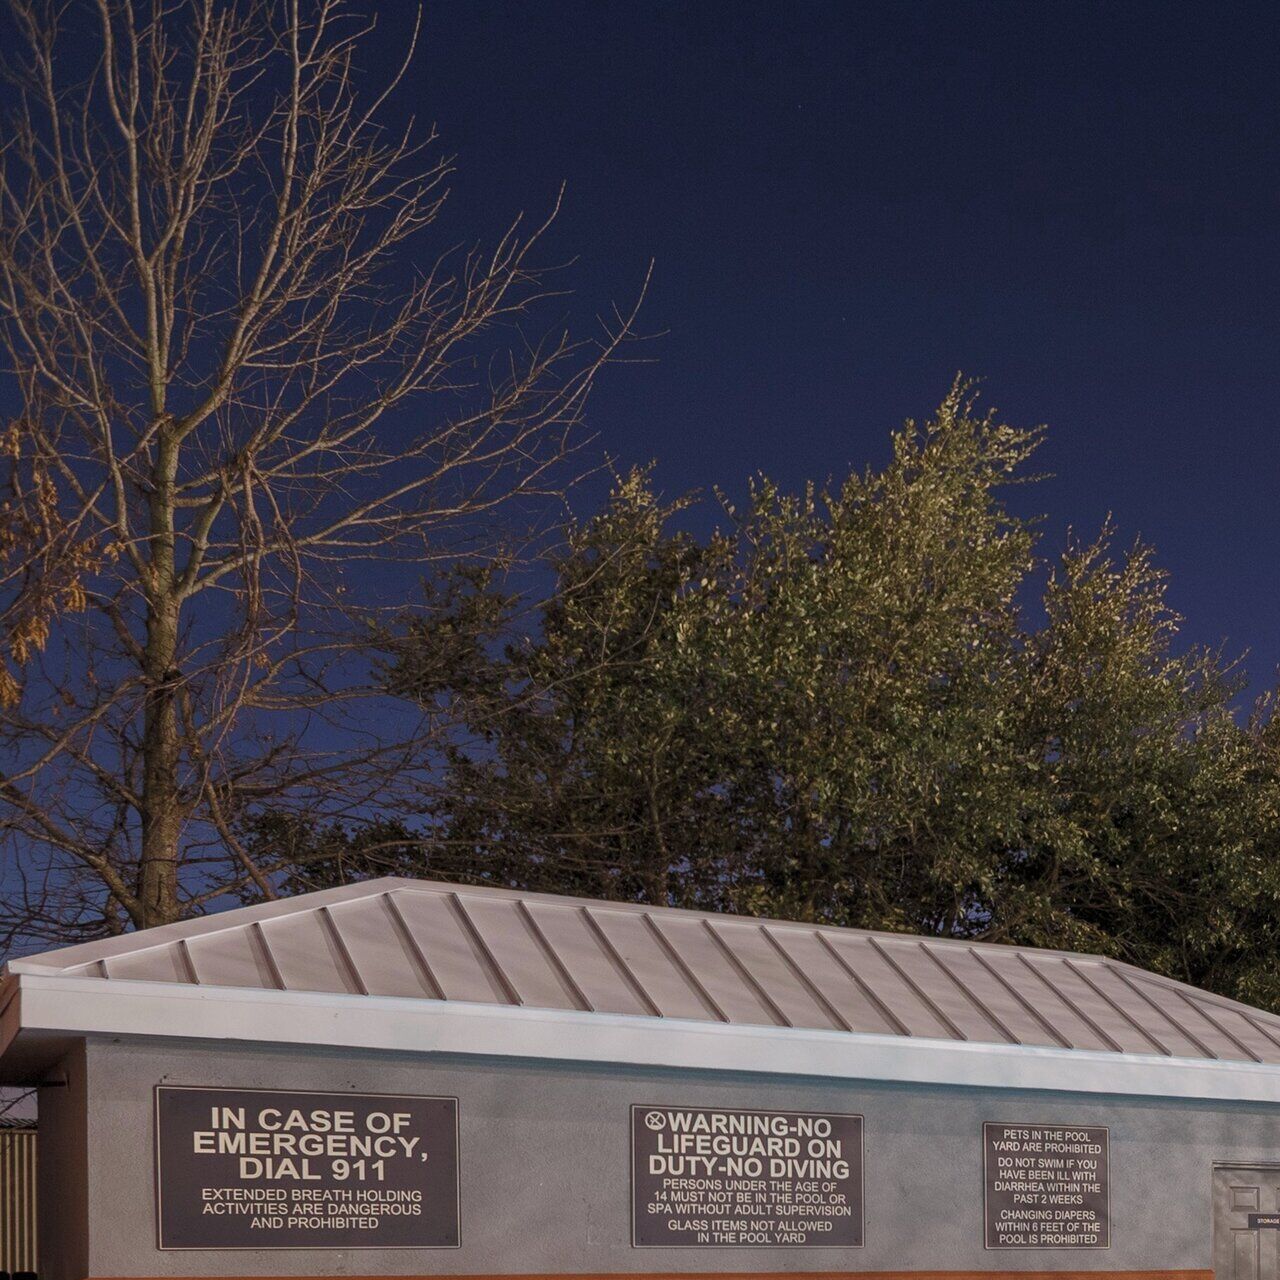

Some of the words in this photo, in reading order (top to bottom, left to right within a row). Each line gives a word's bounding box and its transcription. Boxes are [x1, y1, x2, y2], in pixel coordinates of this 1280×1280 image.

[211, 1107, 246, 1129] IN
[258, 1108, 355, 1133] CASE
[366, 1112, 412, 1134] OF
[1003, 1129, 1030, 1140] PETS
[1031, 1130, 1042, 1140] IN
[1044, 1130, 1063, 1141] THE
[1065, 1131, 1091, 1142] POOL
[193, 1131, 429, 1162] EMERGENCY,
[657, 1133, 800, 1157] LIFEGUARD
[807, 1139, 842, 1159] ON
[992, 1141, 1020, 1152] YARD
[1022, 1142, 1043, 1152] ARE
[1044, 1142, 1102, 1154] PROHIBITED
[239, 1157, 322, 1180] DIAL
[332, 1159, 385, 1181] 911
[770, 1159, 850, 1180] DIVING
[998, 1157, 1013, 1167] DO
[1015, 1158, 1036, 1168] NOT
[1037, 1158, 1064, 1169] SWIM
[1066, 1159, 1075, 1169] IF
[1077, 1160, 1097, 1170] YOU
[999, 1170, 1026, 1180] HAVE
[1028, 1170, 1055, 1180] BEEN
[1057, 1171, 1070, 1181] ILL
[1072, 1171, 1096, 1181] WITH
[663, 1178, 722, 1191] PERSONS
[725, 1180, 767, 1191] UNDER
[769, 1181, 792, 1192] THE
[794, 1181, 818, 1193] AGE
[821, 1182, 837, 1193] OF
[994, 1181, 1045, 1192] DIARRHEA
[1046, 1182, 1080, 1192] WITHIN
[1082, 1183, 1101, 1193] THE
[202, 1188, 287, 1201] EXTENDED
[291, 1189, 352, 1201] BREATH
[356, 1190, 423, 1202] HOLDING
[654, 1191, 668, 1201] 14
[671, 1191, 704, 1202] MUST
[708, 1192, 733, 1203] NOT
[736, 1192, 752, 1203] BE
[755, 1193, 767, 1203] IN
[769, 1193, 792, 1204] THE
[795, 1193, 826, 1205] POOL
[828, 1194, 846, 1205] OR
[1013, 1194, 1039, 1204] PAST
[1041, 1194, 1047, 1204] 2
[1049, 1194, 1083, 1205] WEEKS
[202, 1202, 289, 1215] ACTIVITIES
[292, 1203, 324, 1215] ARE
[328, 1203, 422, 1216] DANGEROUS
[647, 1203, 673, 1214] SPA
[675, 1203, 731, 1215] WITHOUT
[734, 1204, 772, 1216] ADULT
[775, 1205, 852, 1216] SUPERVISION
[1000, 1209, 1053, 1220] CHANGING
[1055, 1210, 1096, 1220] DIAPERS
[250, 1217, 284, 1229] AND
[287, 1217, 379, 1229] PROHIBITED
[667, 1219, 709, 1231] GLASS
[711, 1220, 748, 1231] ITEMS
[750, 1220, 774, 1231] NOT
[777, 1220, 833, 1232] ALLOWED
[995, 1222, 1030, 1232] WITHIN
[1032, 1222, 1038, 1232] 6
[1040, 1222, 1065, 1232] FEET
[1066, 1222, 1080, 1232] OF
[1082, 1222, 1101, 1232] THE
[697, 1232, 709, 1243] IN
[712, 1232, 737, 1243] THE
[739, 1232, 773, 1244] POOL
[774, 1232, 806, 1244] YARD
[999, 1234, 1026, 1244] POOL
[1029, 1234, 1039, 1244] IS
[1040, 1234, 1098, 1244] PROHIBITED
